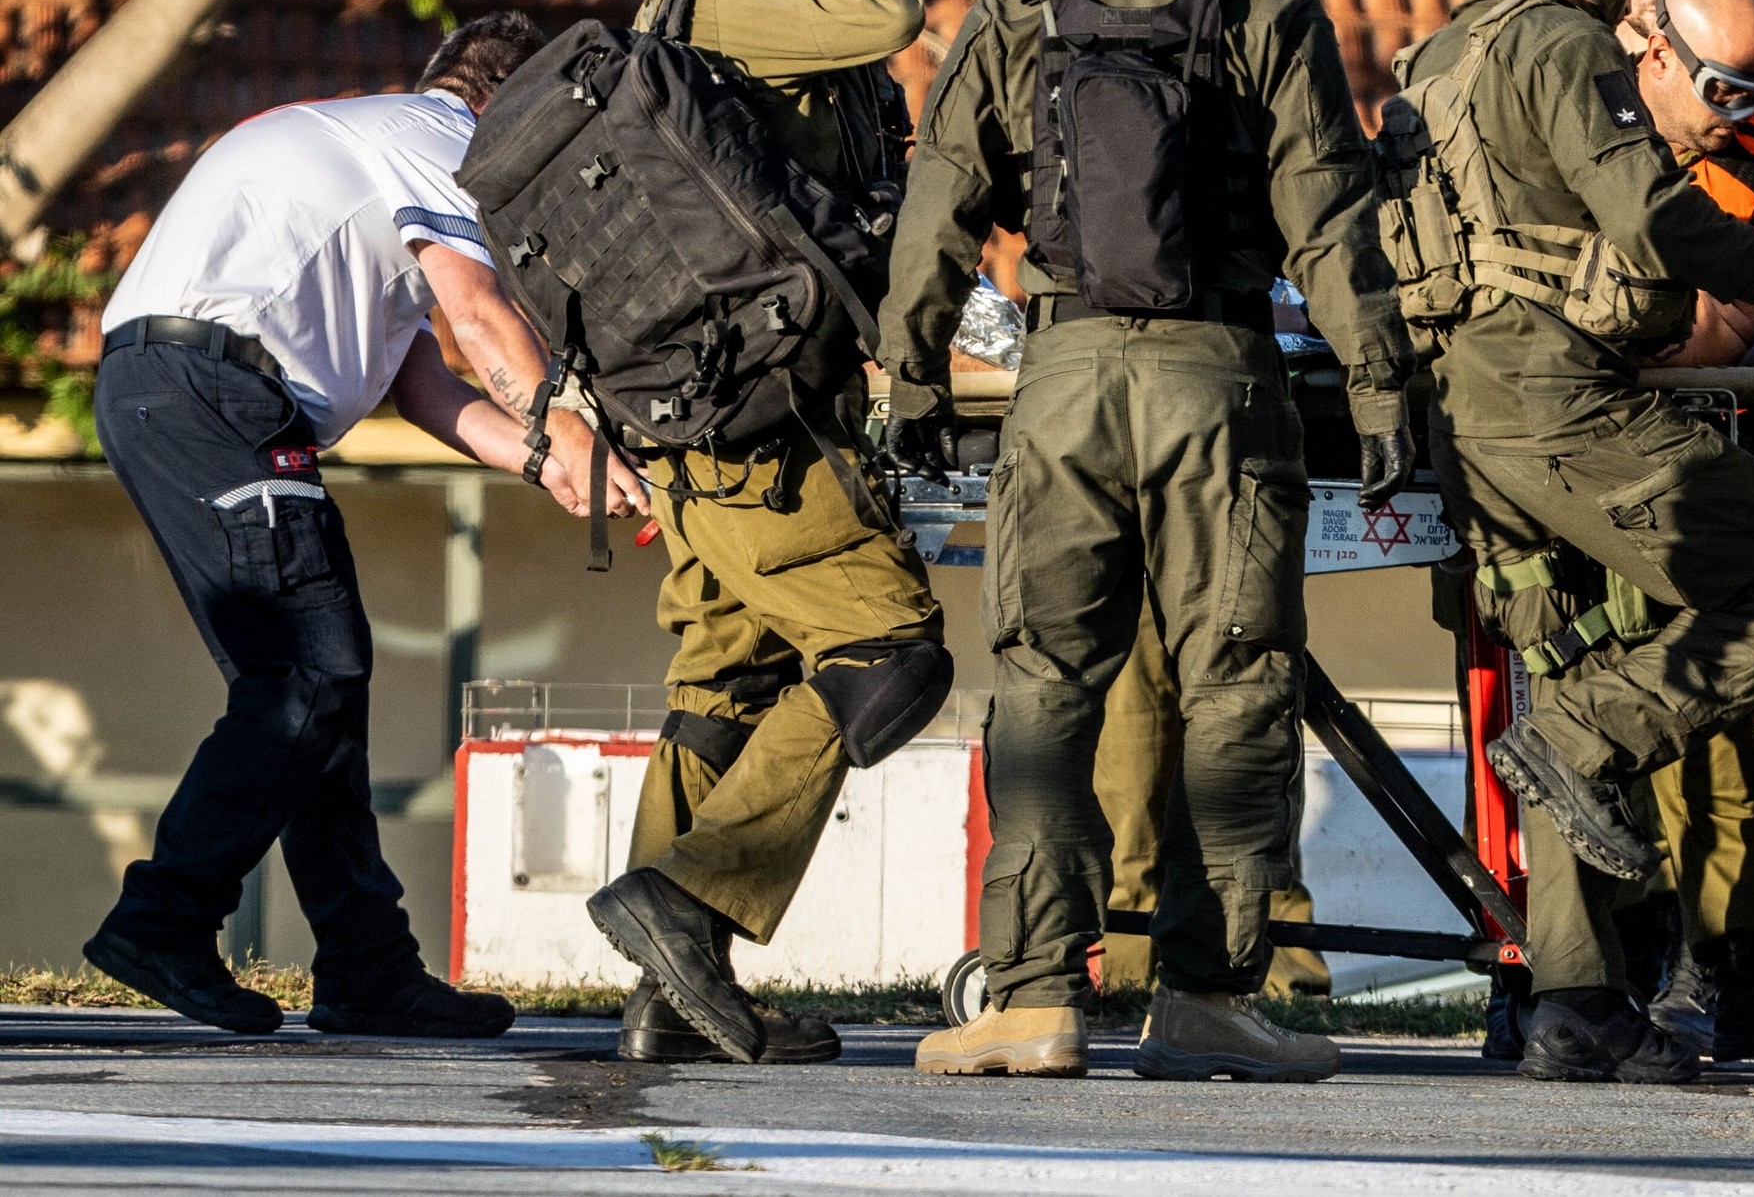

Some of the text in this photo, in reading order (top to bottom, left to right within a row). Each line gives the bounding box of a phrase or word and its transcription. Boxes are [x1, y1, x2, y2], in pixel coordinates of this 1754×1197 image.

[1322, 509, 1352, 518] MAGEN
[1322, 518, 1348, 526] DAVID
[1322, 525, 1348, 533] ADOM
[1321, 533, 1359, 542] IN ISRAEL
[1310, 549, 1358, 561] מגן דוד
